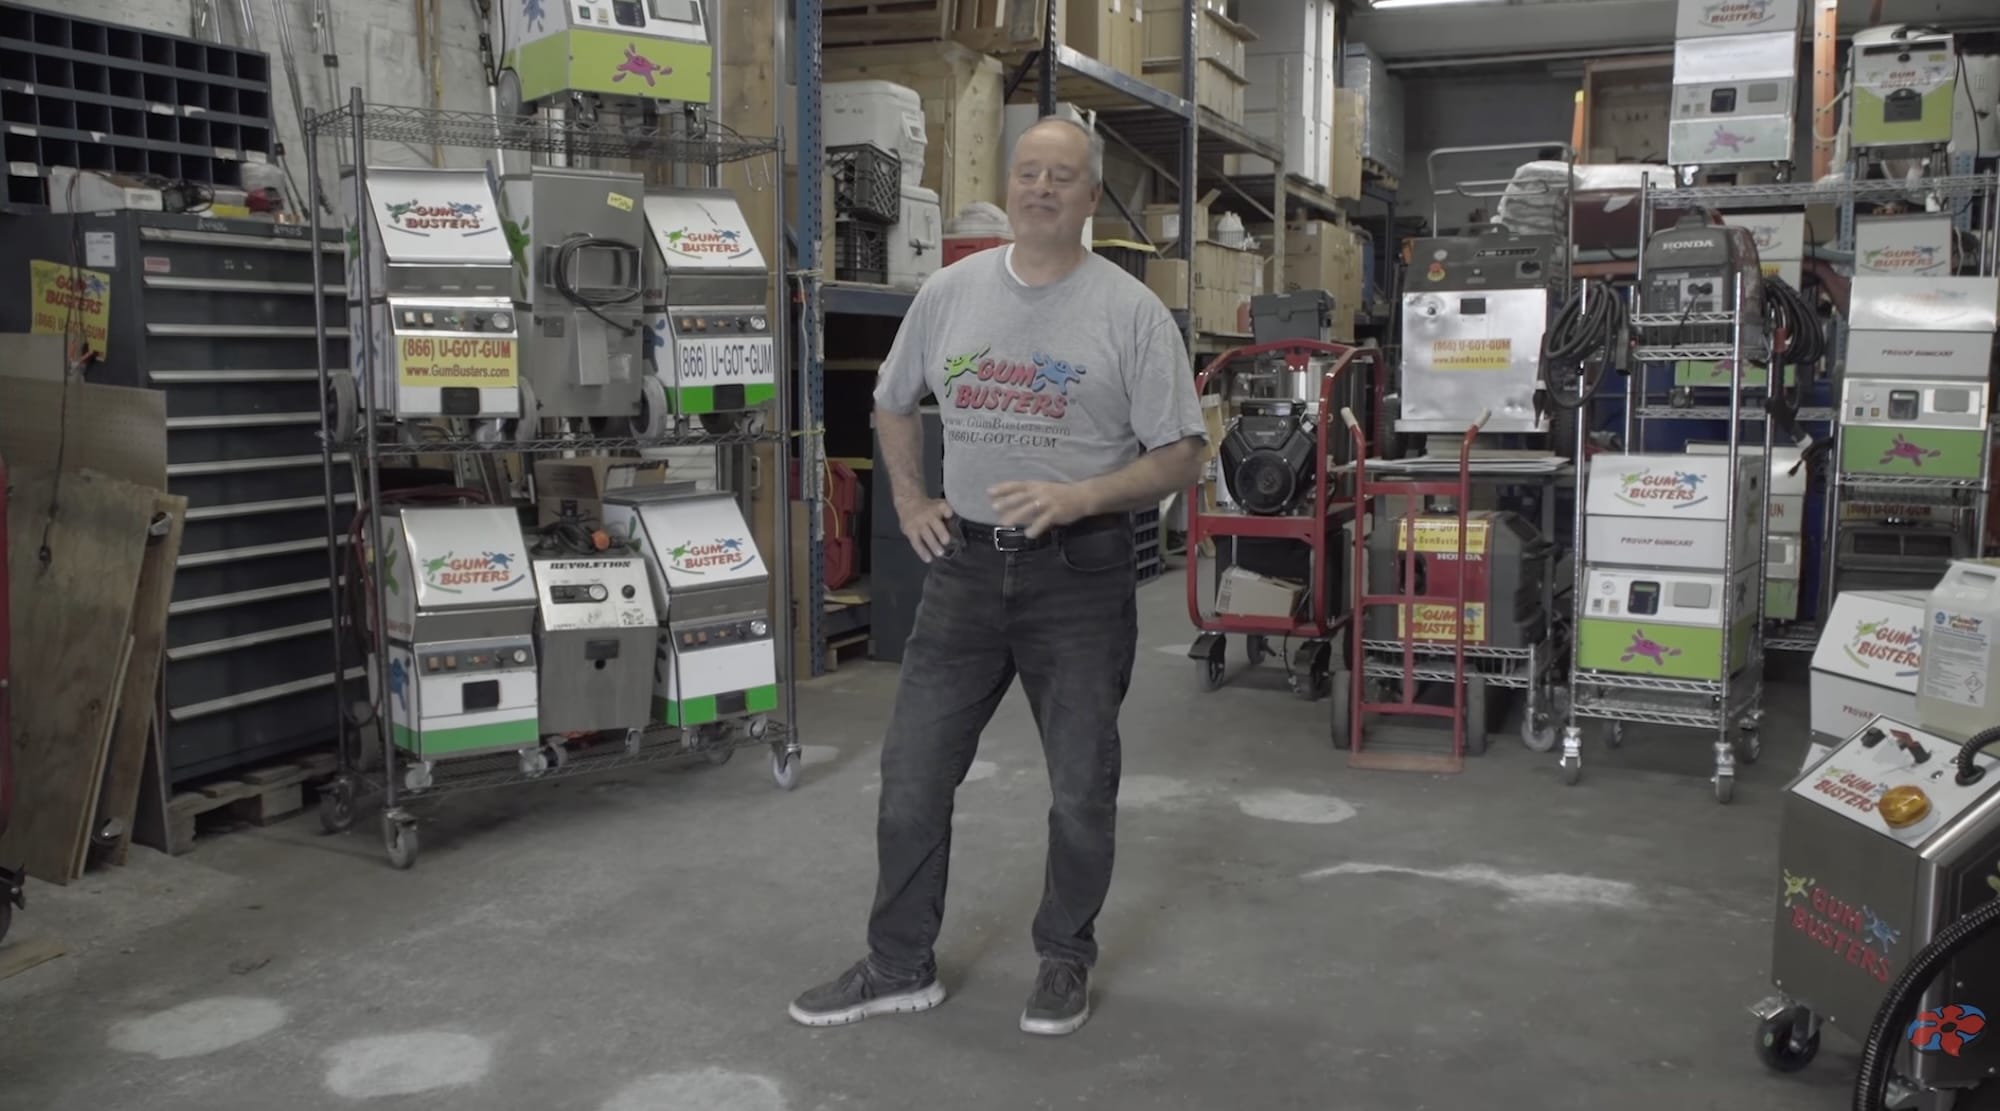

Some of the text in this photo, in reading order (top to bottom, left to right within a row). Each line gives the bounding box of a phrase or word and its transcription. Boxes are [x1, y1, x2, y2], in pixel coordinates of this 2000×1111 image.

[415, 206, 457, 217] GUM
[404, 218, 480, 229] BUSTERS
[687, 232, 720, 243] GUM
[1662, 239, 1715, 250] HONDA
[681, 241, 740, 253] BUSTERS
[402, 338, 512, 361] (866) U-GOT-GUM
[679, 343, 772, 381] (866) U-GOT-GUM
[405, 363, 511, 378] www.GumBusters.com
[977, 358, 1036, 388] GUM
[955, 384, 1068, 419] BUSTERS
[1642, 475, 1678, 487] GUM
[1629, 487, 1695, 501] BUSTERS
[689, 544, 723, 557] GUM
[450, 557, 488, 571] GUM
[684, 552, 743, 569] BUSTERS
[439, 570, 510, 586] BUSTERS
[1876, 627, 1912, 646] GUM
[1840, 773, 1877, 794] GUM
[1813, 779, 1874, 813] BUSTERS
[1812, 886, 1864, 932] GUM
[1791, 904, 1888, 985] BUSTERS
